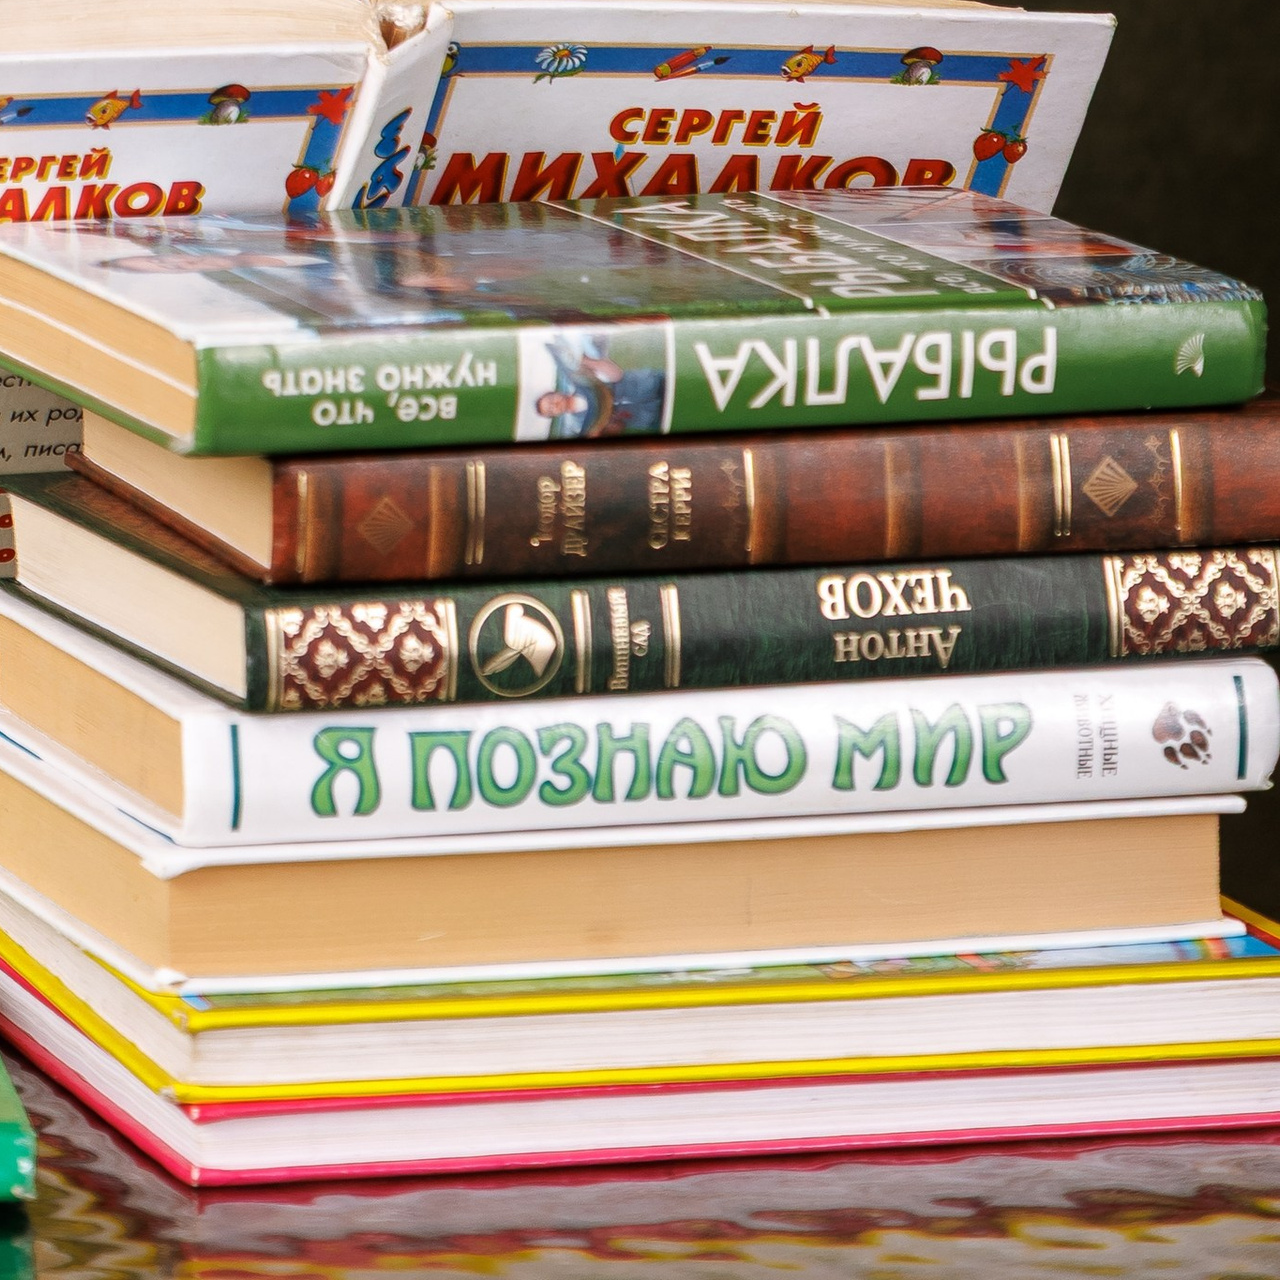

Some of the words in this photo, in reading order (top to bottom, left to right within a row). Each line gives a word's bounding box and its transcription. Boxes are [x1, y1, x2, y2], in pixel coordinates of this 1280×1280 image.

[609, 101, 823, 148] СЕРГЕЙ
[614, 202, 940, 298] РЫБАЛКА
[693, 327, 1058, 413] РЫБАЛКА
[10, 409, 39, 423] их
[24, 441, 82, 458] писа
[817, 568, 972, 620] ЧЕХОВ
[310, 725, 383, 818] Я
[407, 714, 808, 812] ПОЗНАЮ
[831, 701, 1034, 791] МИР
